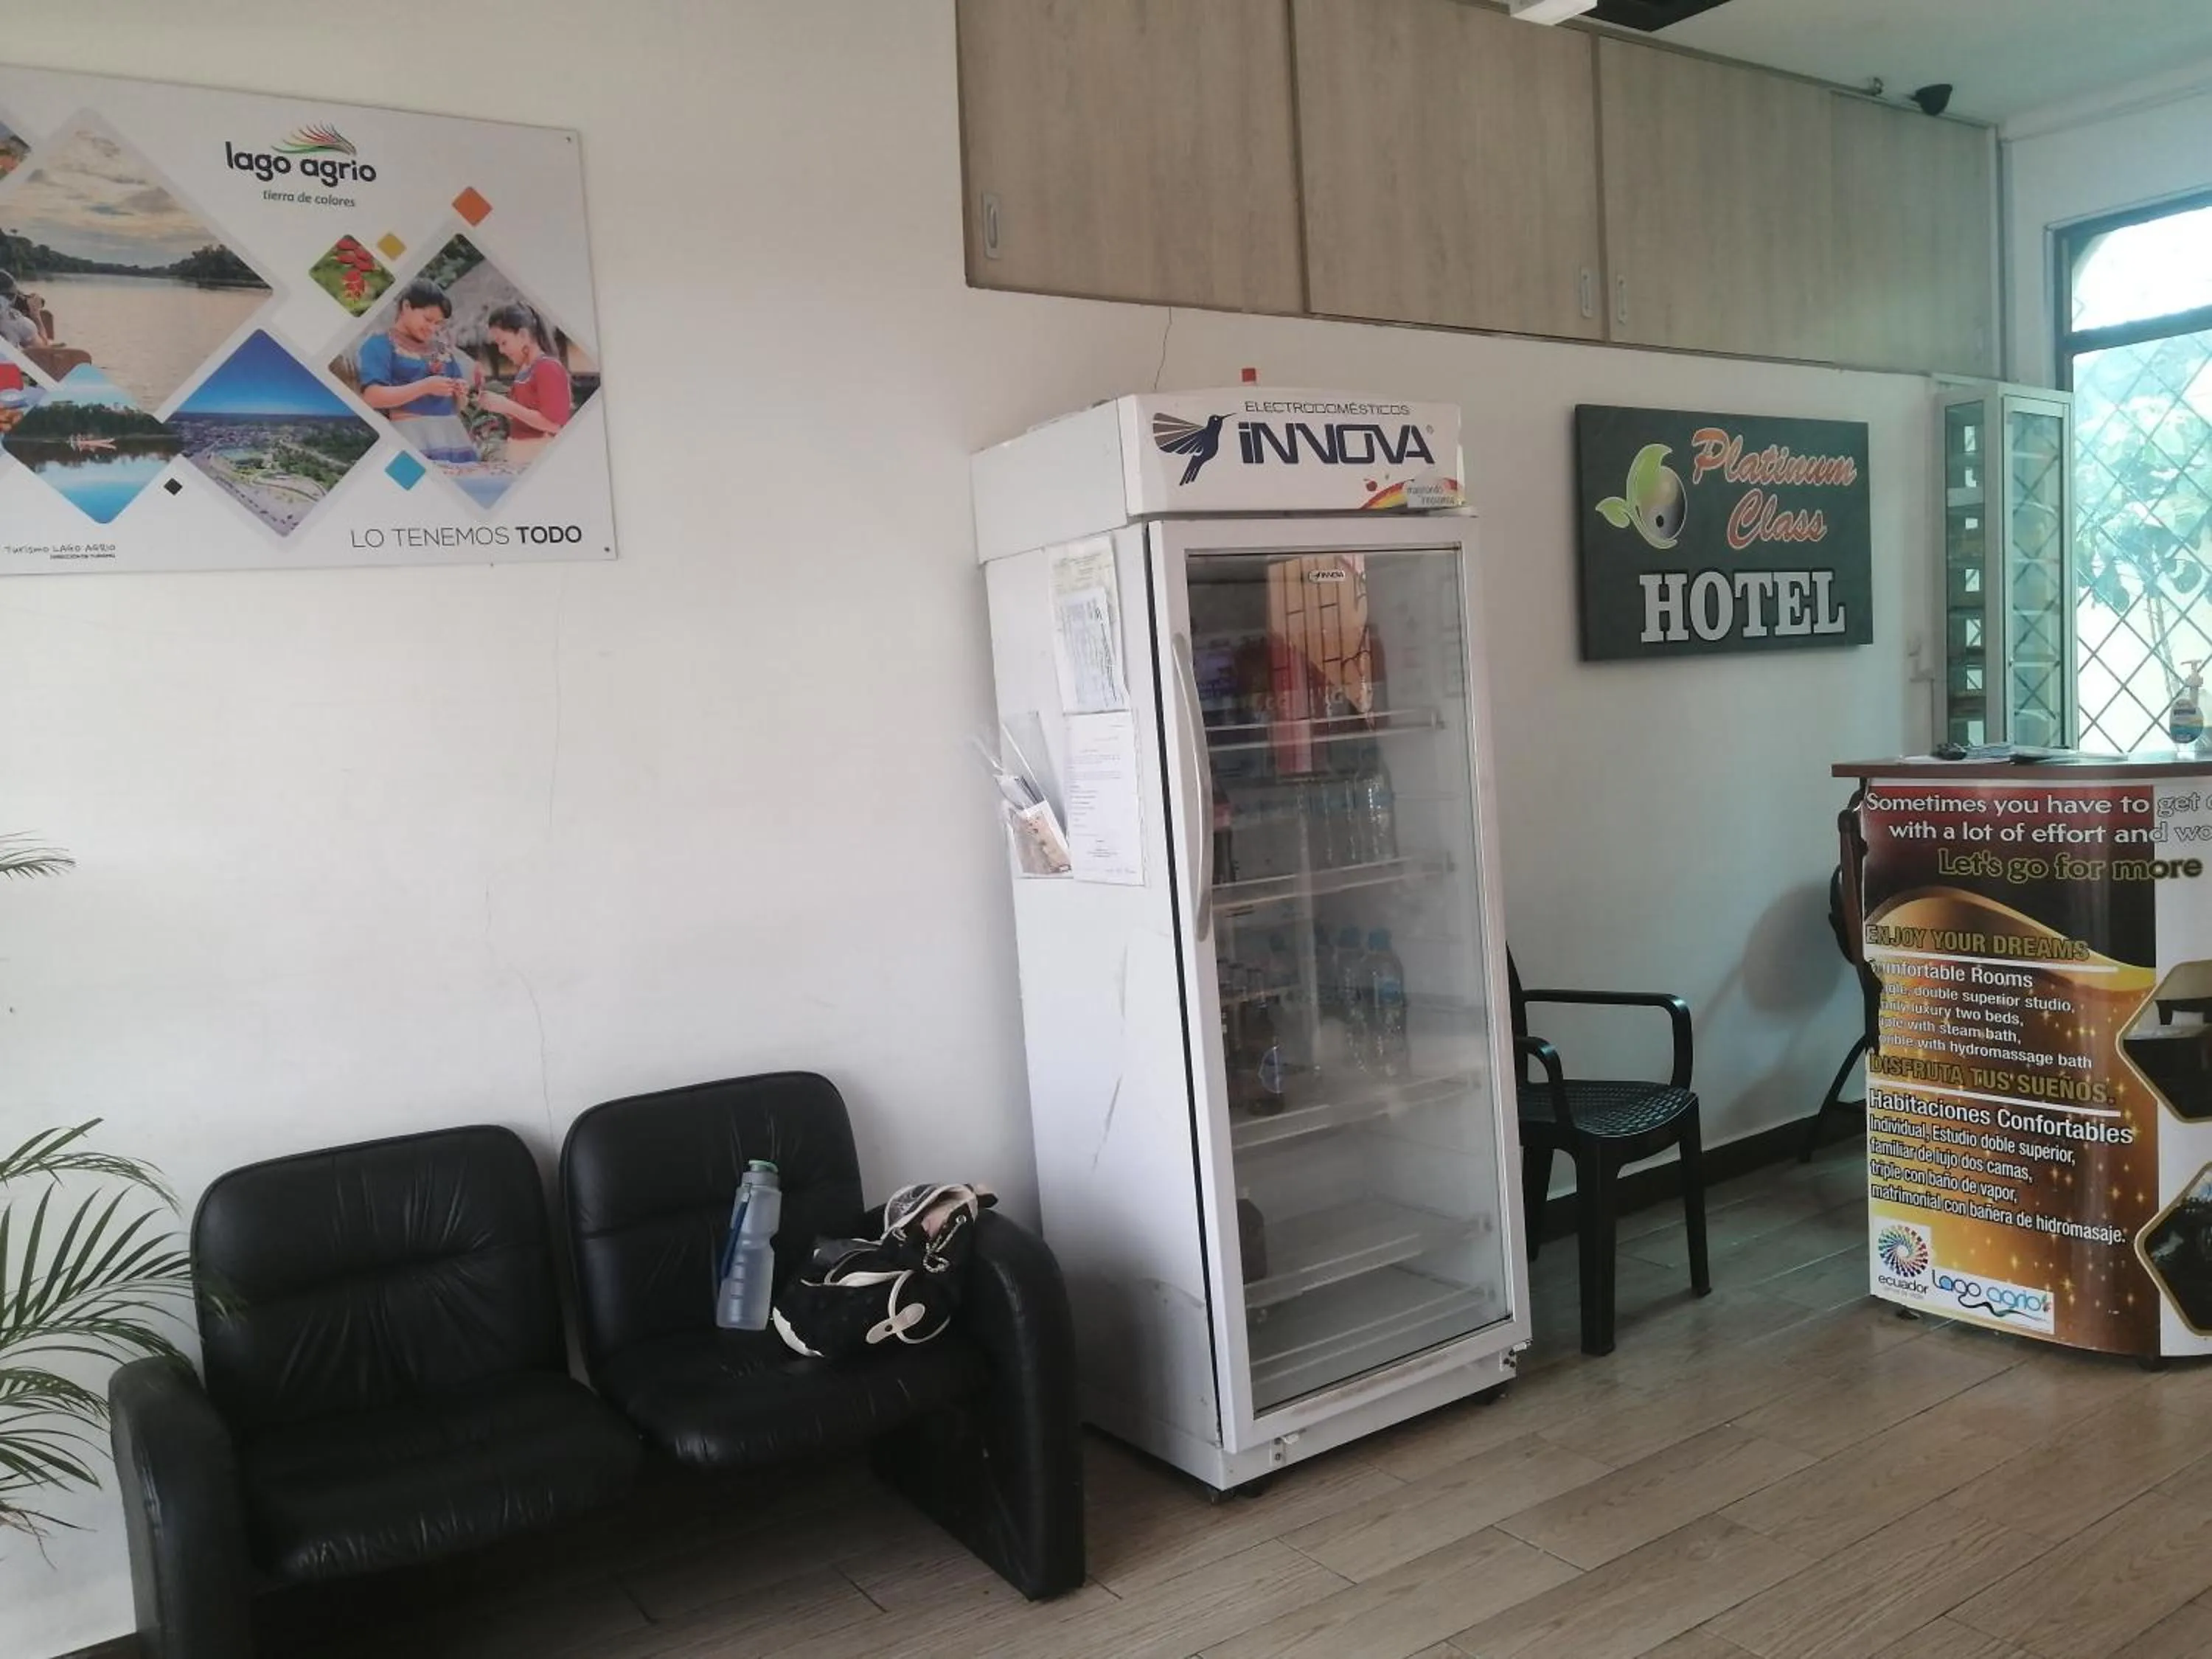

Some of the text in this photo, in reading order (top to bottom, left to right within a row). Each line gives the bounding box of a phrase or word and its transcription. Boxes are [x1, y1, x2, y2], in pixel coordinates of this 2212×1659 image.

[225, 140, 377, 188] lago agrio
[262, 189, 355, 207] tierra de colores
[1244, 400, 1411, 416] ELECTRODOMÉSTICOS
[1691, 427, 1858, 486] Platinum
[1727, 487, 1829, 549] Class
[350, 525, 582, 548] LO TENEMOS TODO
[1638, 569, 1846, 644] HOTEL
[1866, 792, 1986, 812] Sometimes
[1993, 799, 2039, 816] you
[2047, 794, 2112, 813] have
[2121, 796, 2149, 813] to
[2156, 791, 2201, 818] get
[1888, 820, 1937, 839] with
[1943, 826, 1955, 840] a
[1962, 821, 1994, 841] lot
[2000, 822, 2025, 842] of
[2031, 823, 2107, 843] effort
[2114, 820, 2168, 843] and
[1938, 848, 2204, 885] Let's go for more
[1865, 924, 2091, 962] ENJOY YOUR DREAMS
[1971, 966, 2034, 988] Rooms
[1912, 1004, 1952, 1019] luxury
[1955, 1006, 1982, 1021] two
[1914, 987, 1958, 1001] double
[1962, 992, 2021, 1008] superior
[1907, 1019, 1935, 1033] with
[1939, 1023, 1982, 1037] steam
[1917, 1038, 1946, 1051] with
[1950, 1040, 2053, 1066] hydromassage
[2058, 1053, 2093, 1069] bath
[1869, 1053, 1964, 1085] DISFRUTA
[1969, 1067, 2011, 1091] TUS
[1869, 1088, 2134, 1144] Habitaciones Confortables
[1869, 1113, 2076, 1167] Individual, Estudio doble superior,
[1870, 1136, 2034, 1183] familiar de lujo dos camas,
[1870, 1158, 1902, 1181] triple
[1904, 1167, 1926, 1184] con
[1927, 1170, 1958, 1190] baño
[1961, 1177, 1978, 1194] de
[1871, 1183, 2126, 1245] matrimonial con bañera de hidromasaje.
[1878, 1274, 1929, 1295] ecuador
[1986, 1286, 2042, 1311] agrio
